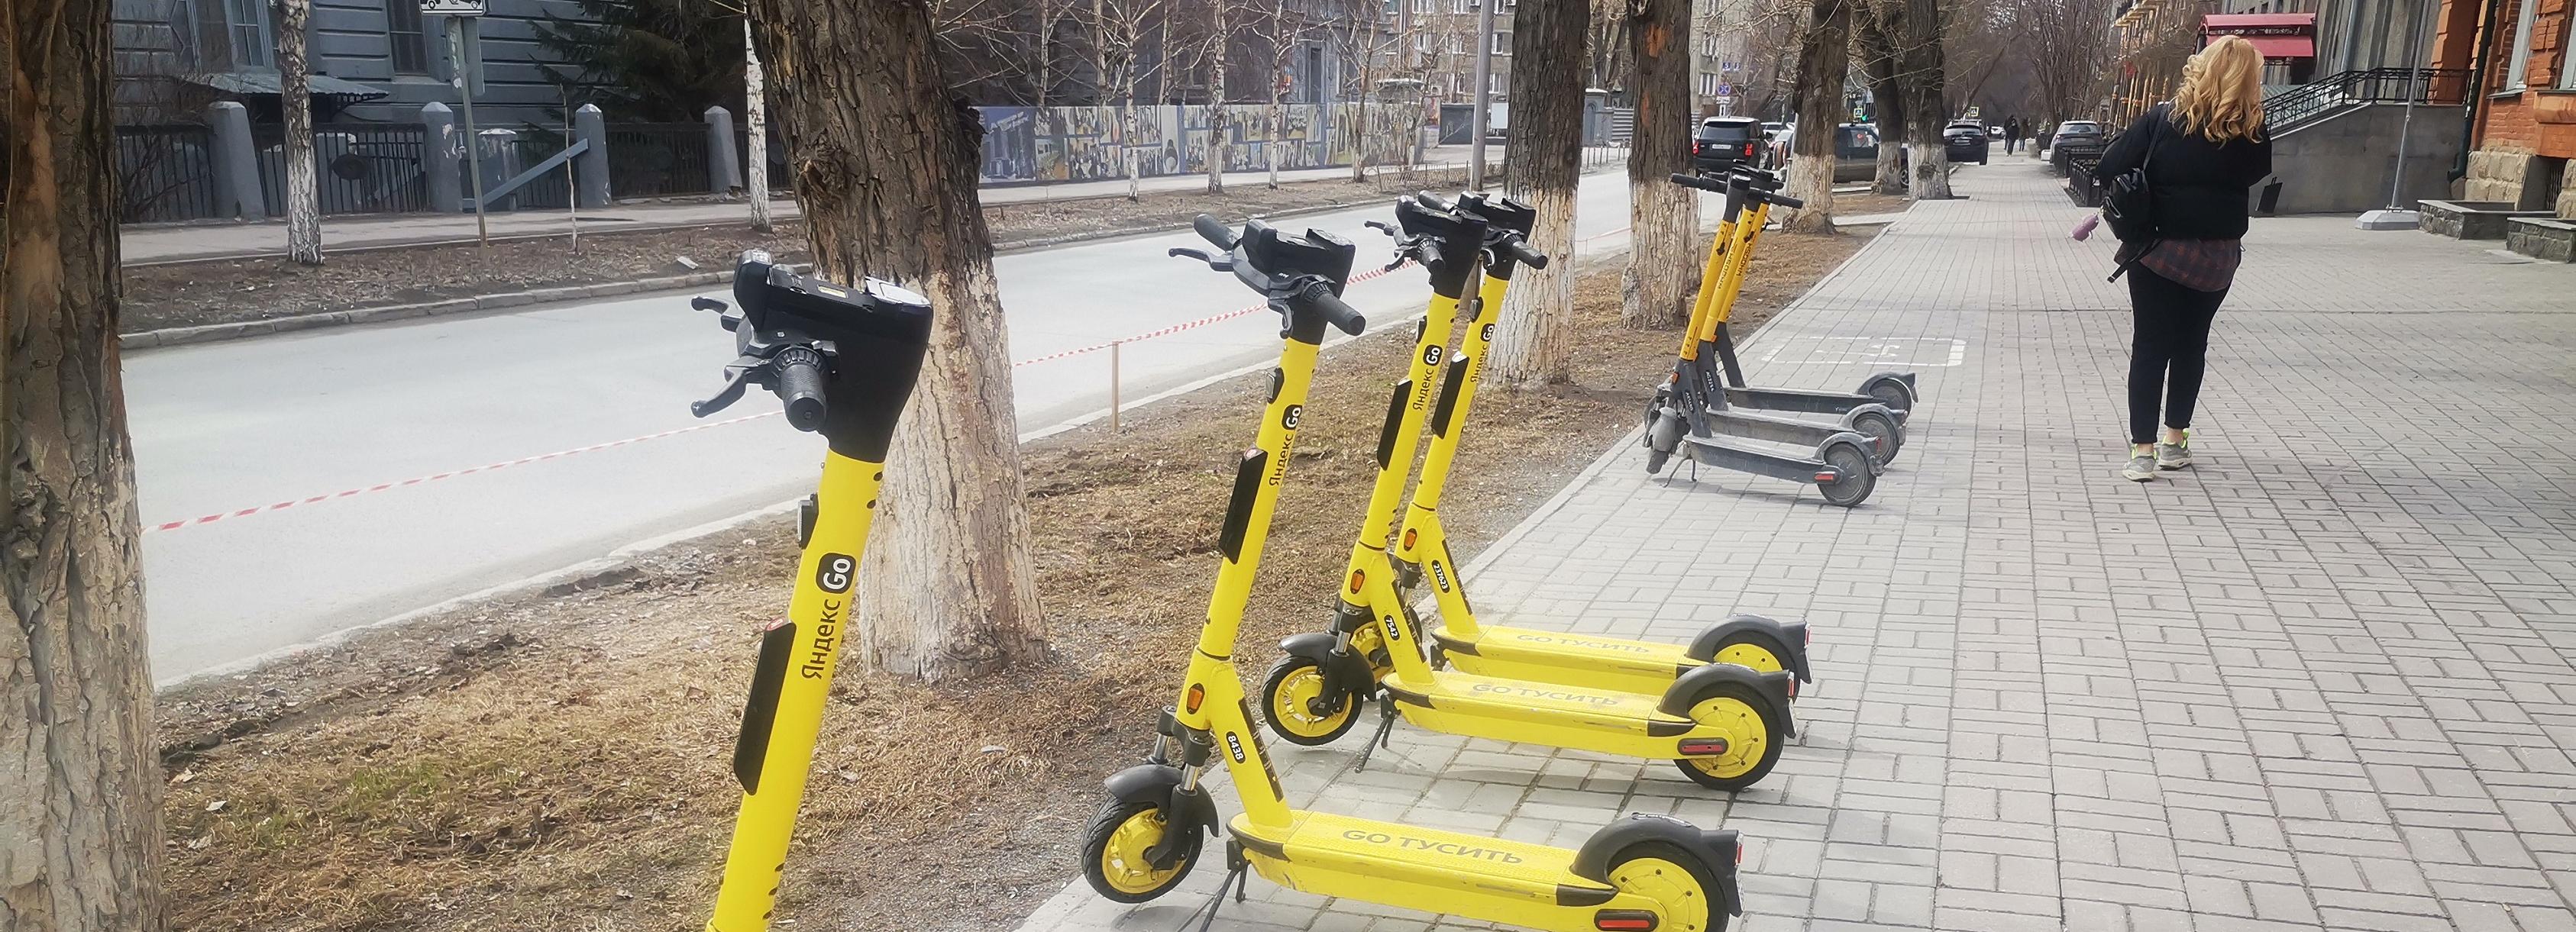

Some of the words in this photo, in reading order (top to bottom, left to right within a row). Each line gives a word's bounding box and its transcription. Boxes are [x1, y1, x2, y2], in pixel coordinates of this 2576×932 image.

[1736, 243, 1753, 276] WHOOSH
[1470, 344, 1488, 383] Яндекс
[1483, 325, 1494, 340] Go
[1412, 369, 1433, 411] Яндекс
[1426, 347, 1440, 364] Go
[1269, 434, 1294, 486] Яндекс
[1285, 408, 1301, 427] Go
[1433, 563, 1448, 589] 237623
[801, 598, 841, 679] Яндекс
[823, 558, 851, 590] Go
[1385, 618, 1398, 637] 7542
[1517, 634, 1553, 643] GO
[1559, 638, 1650, 653] ТУСИТЬ
[1472, 684, 1511, 694] GO
[1519, 689, 1618, 705] ТУСИТЬ
[1228, 735, 1244, 760] 8438
[1343, 830, 1391, 843] GO
[1399, 837, 1523, 864] ТУСИТЬ
